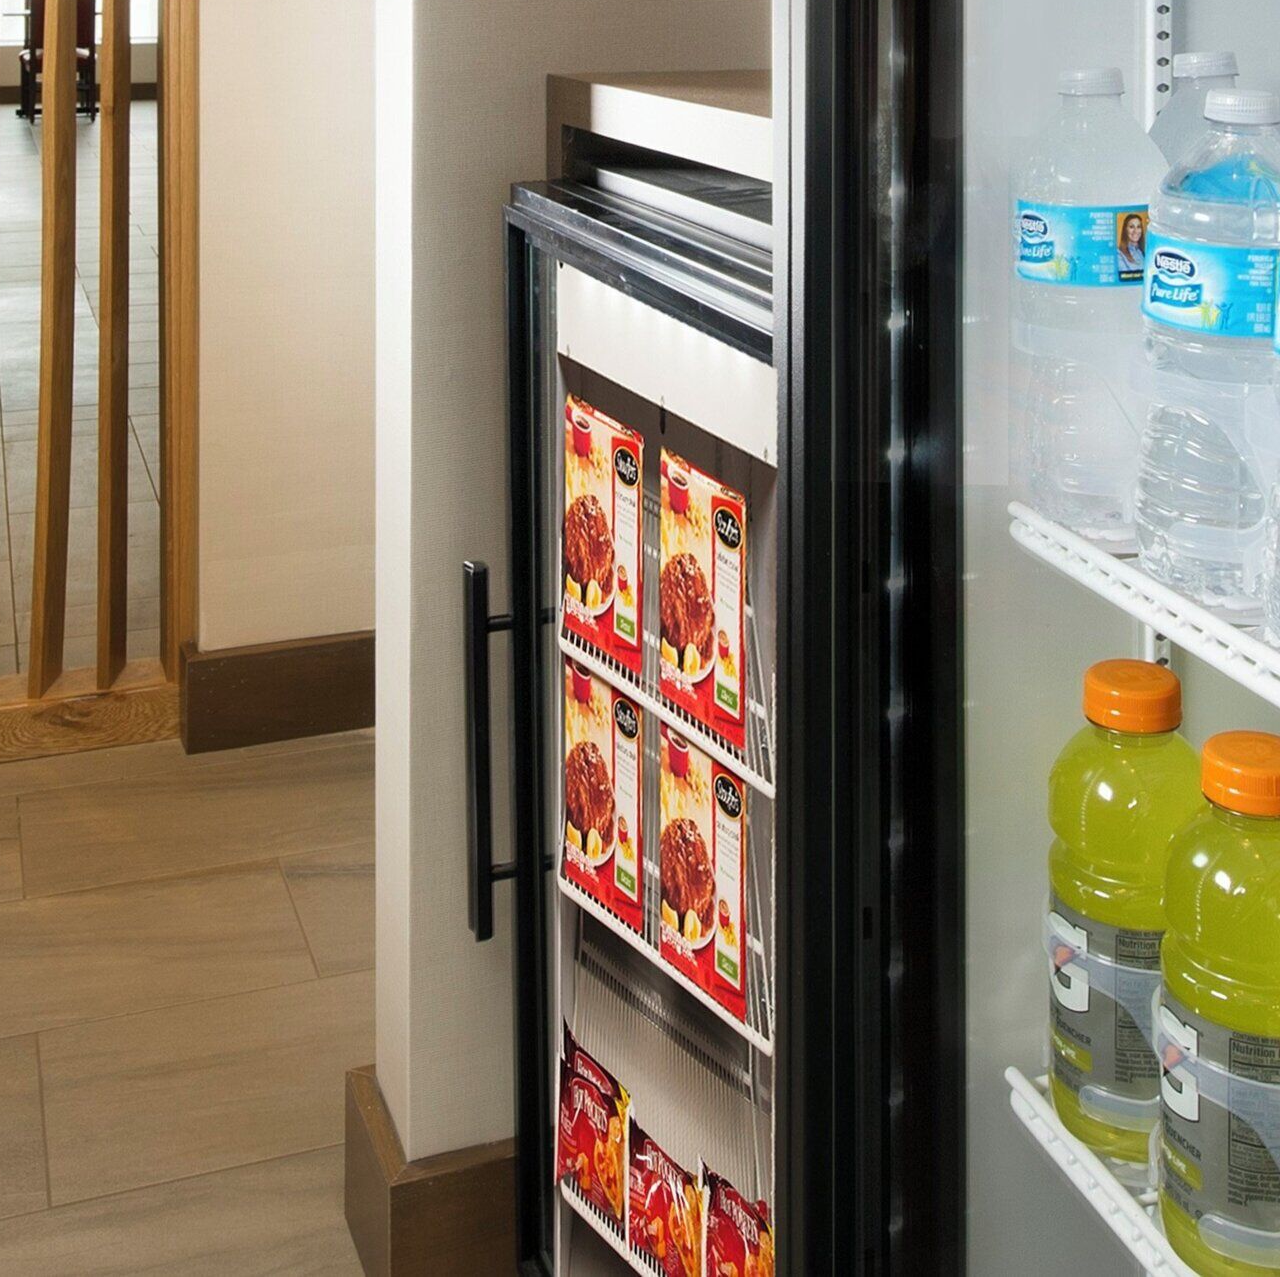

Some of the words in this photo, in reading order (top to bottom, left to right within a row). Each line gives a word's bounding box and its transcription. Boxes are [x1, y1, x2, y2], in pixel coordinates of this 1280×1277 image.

[1032, 244, 1053, 259] Life
[1173, 286, 1198, 303] Life
[1120, 938, 1156, 951] Nutrition
[1232, 1041, 1277, 1058] Nutrition
